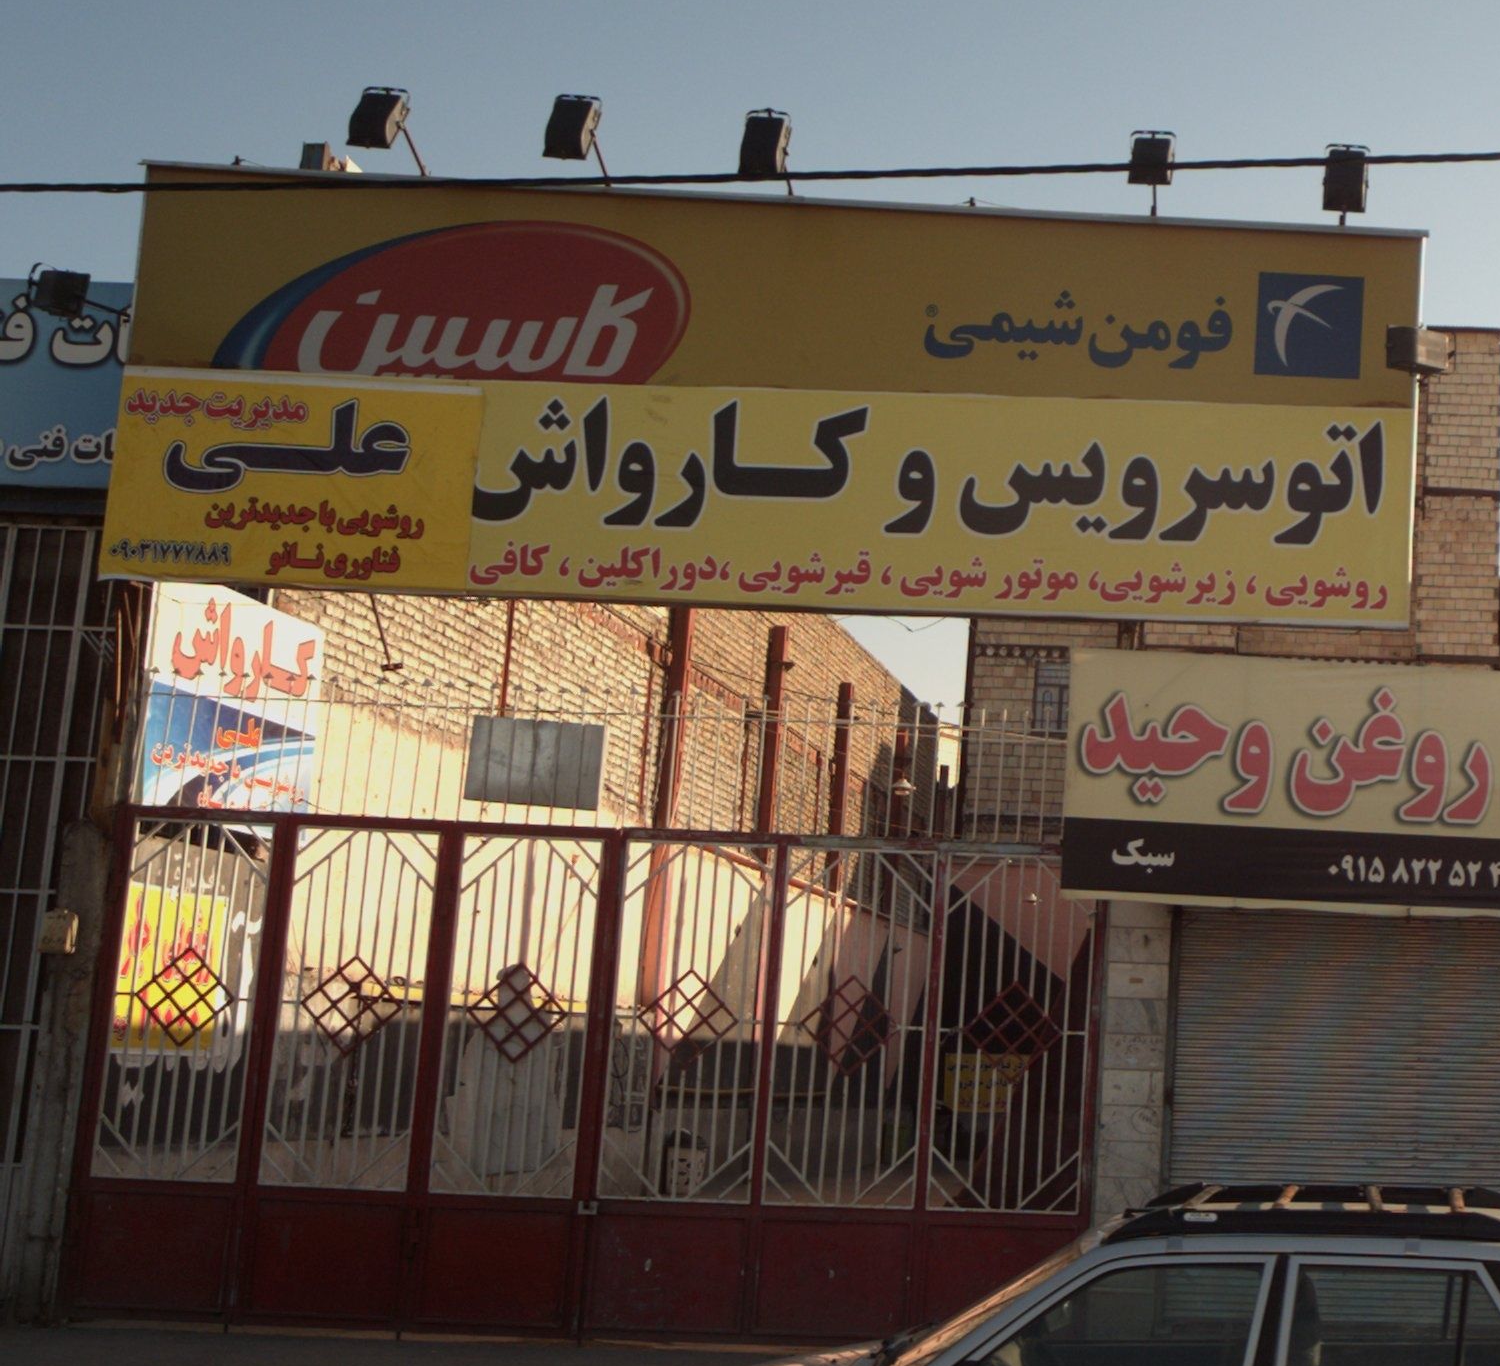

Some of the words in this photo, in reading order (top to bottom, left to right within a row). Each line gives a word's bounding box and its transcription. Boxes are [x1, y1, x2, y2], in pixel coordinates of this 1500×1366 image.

[924, 290, 1083, 359] شیمی
[1088, 296, 1233, 369] فومن
[126, 389, 204, 425] جدید
[203, 392, 308, 428] مدیریت
[7, 425, 69, 470] فنی
[164, 398, 411, 493] علی
[470, 395, 870, 528] کارواش
[883, 449, 937, 534] و
[959, 421, 1384, 546] اتوسرویس
[204, 497, 318, 533] جدیدترین
[317, 499, 336, 534] با
[336, 504, 425, 539] روشویی
[265, 541, 324, 575] نانو
[323, 545, 401, 580] فناوری
[470, 541, 552, 586] کافی
[994, 558, 1079, 600] موتور
[1081, 692, 1275, 813] وحید
[1292, 686, 1493, 825] روغن
[1111, 839, 1176, 875] سبک
[1328, 854, 1386, 884] ۰۹۱۵
[1391, 856, 1443, 886] ۸۲۲
[1448, 859, 1483, 888] ۵۲
